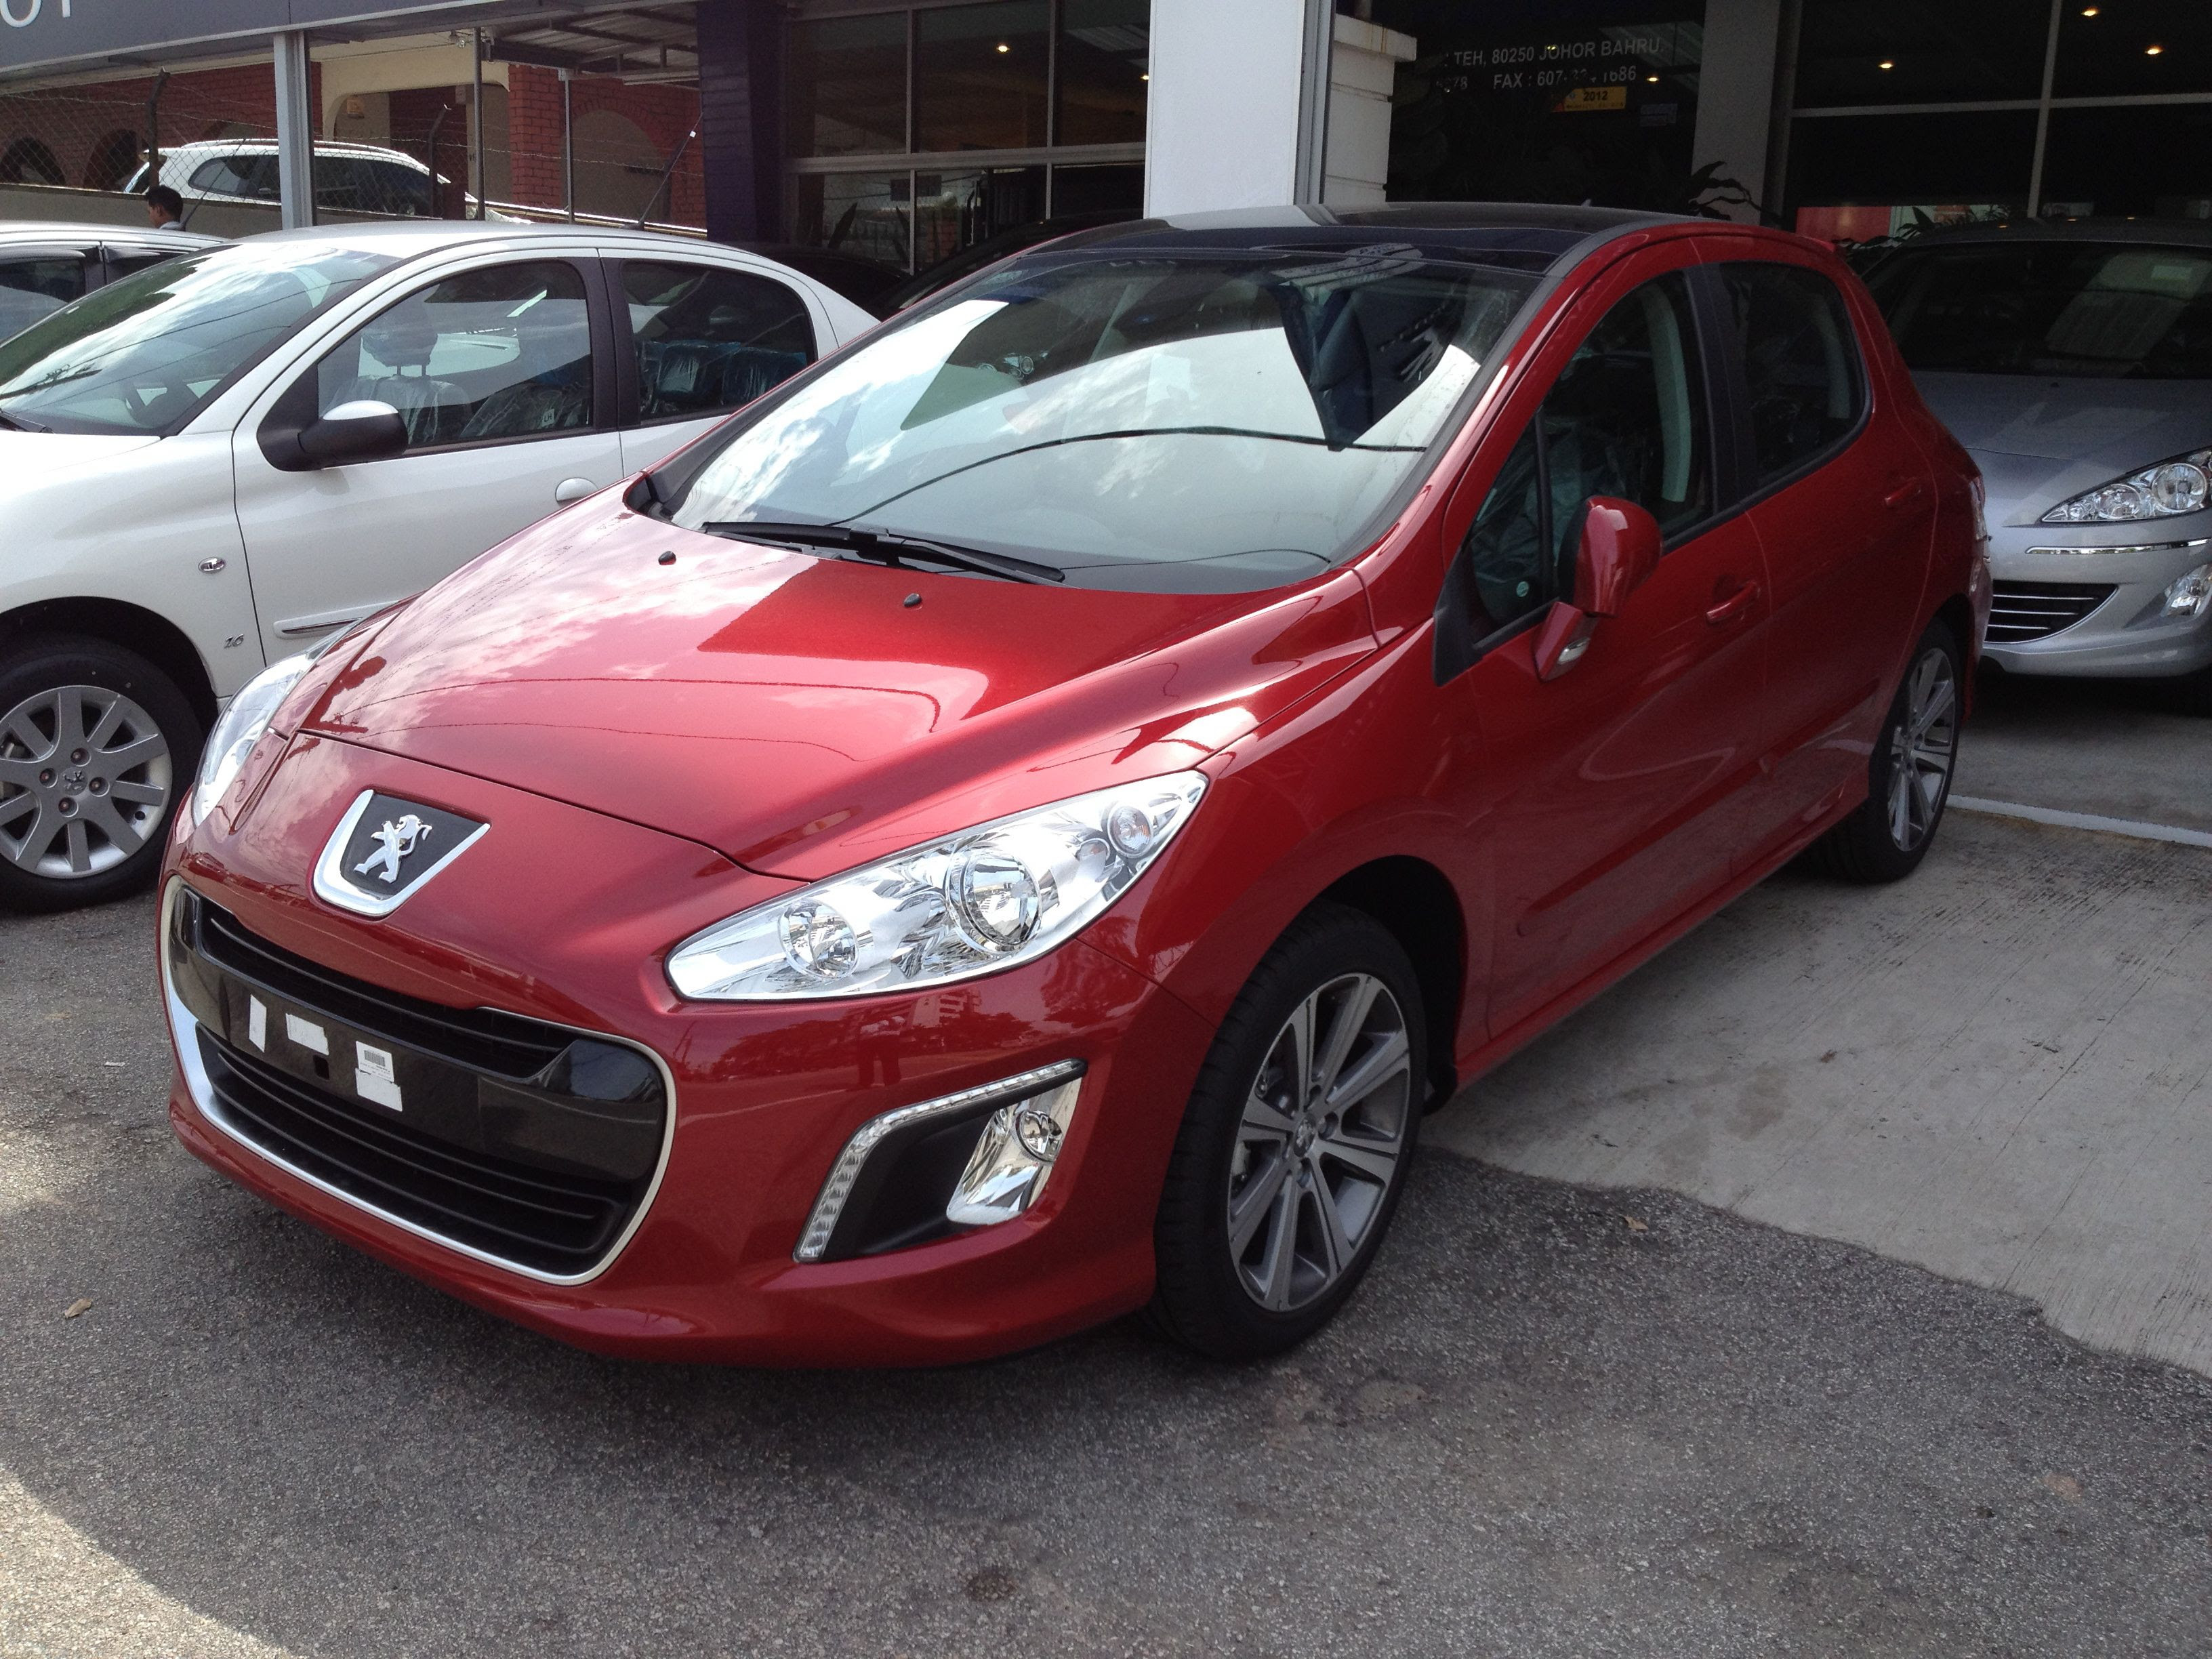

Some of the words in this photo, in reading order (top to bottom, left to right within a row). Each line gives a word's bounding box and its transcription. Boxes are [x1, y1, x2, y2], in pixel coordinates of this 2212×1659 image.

[1454, 50, 1488, 67] TEH,
[1492, 46, 1535, 64] 80250
[1538, 41, 1597, 62] JOHOR
[1493, 72, 1523, 89] FAX
[1582, 90, 1609, 102] 2012
